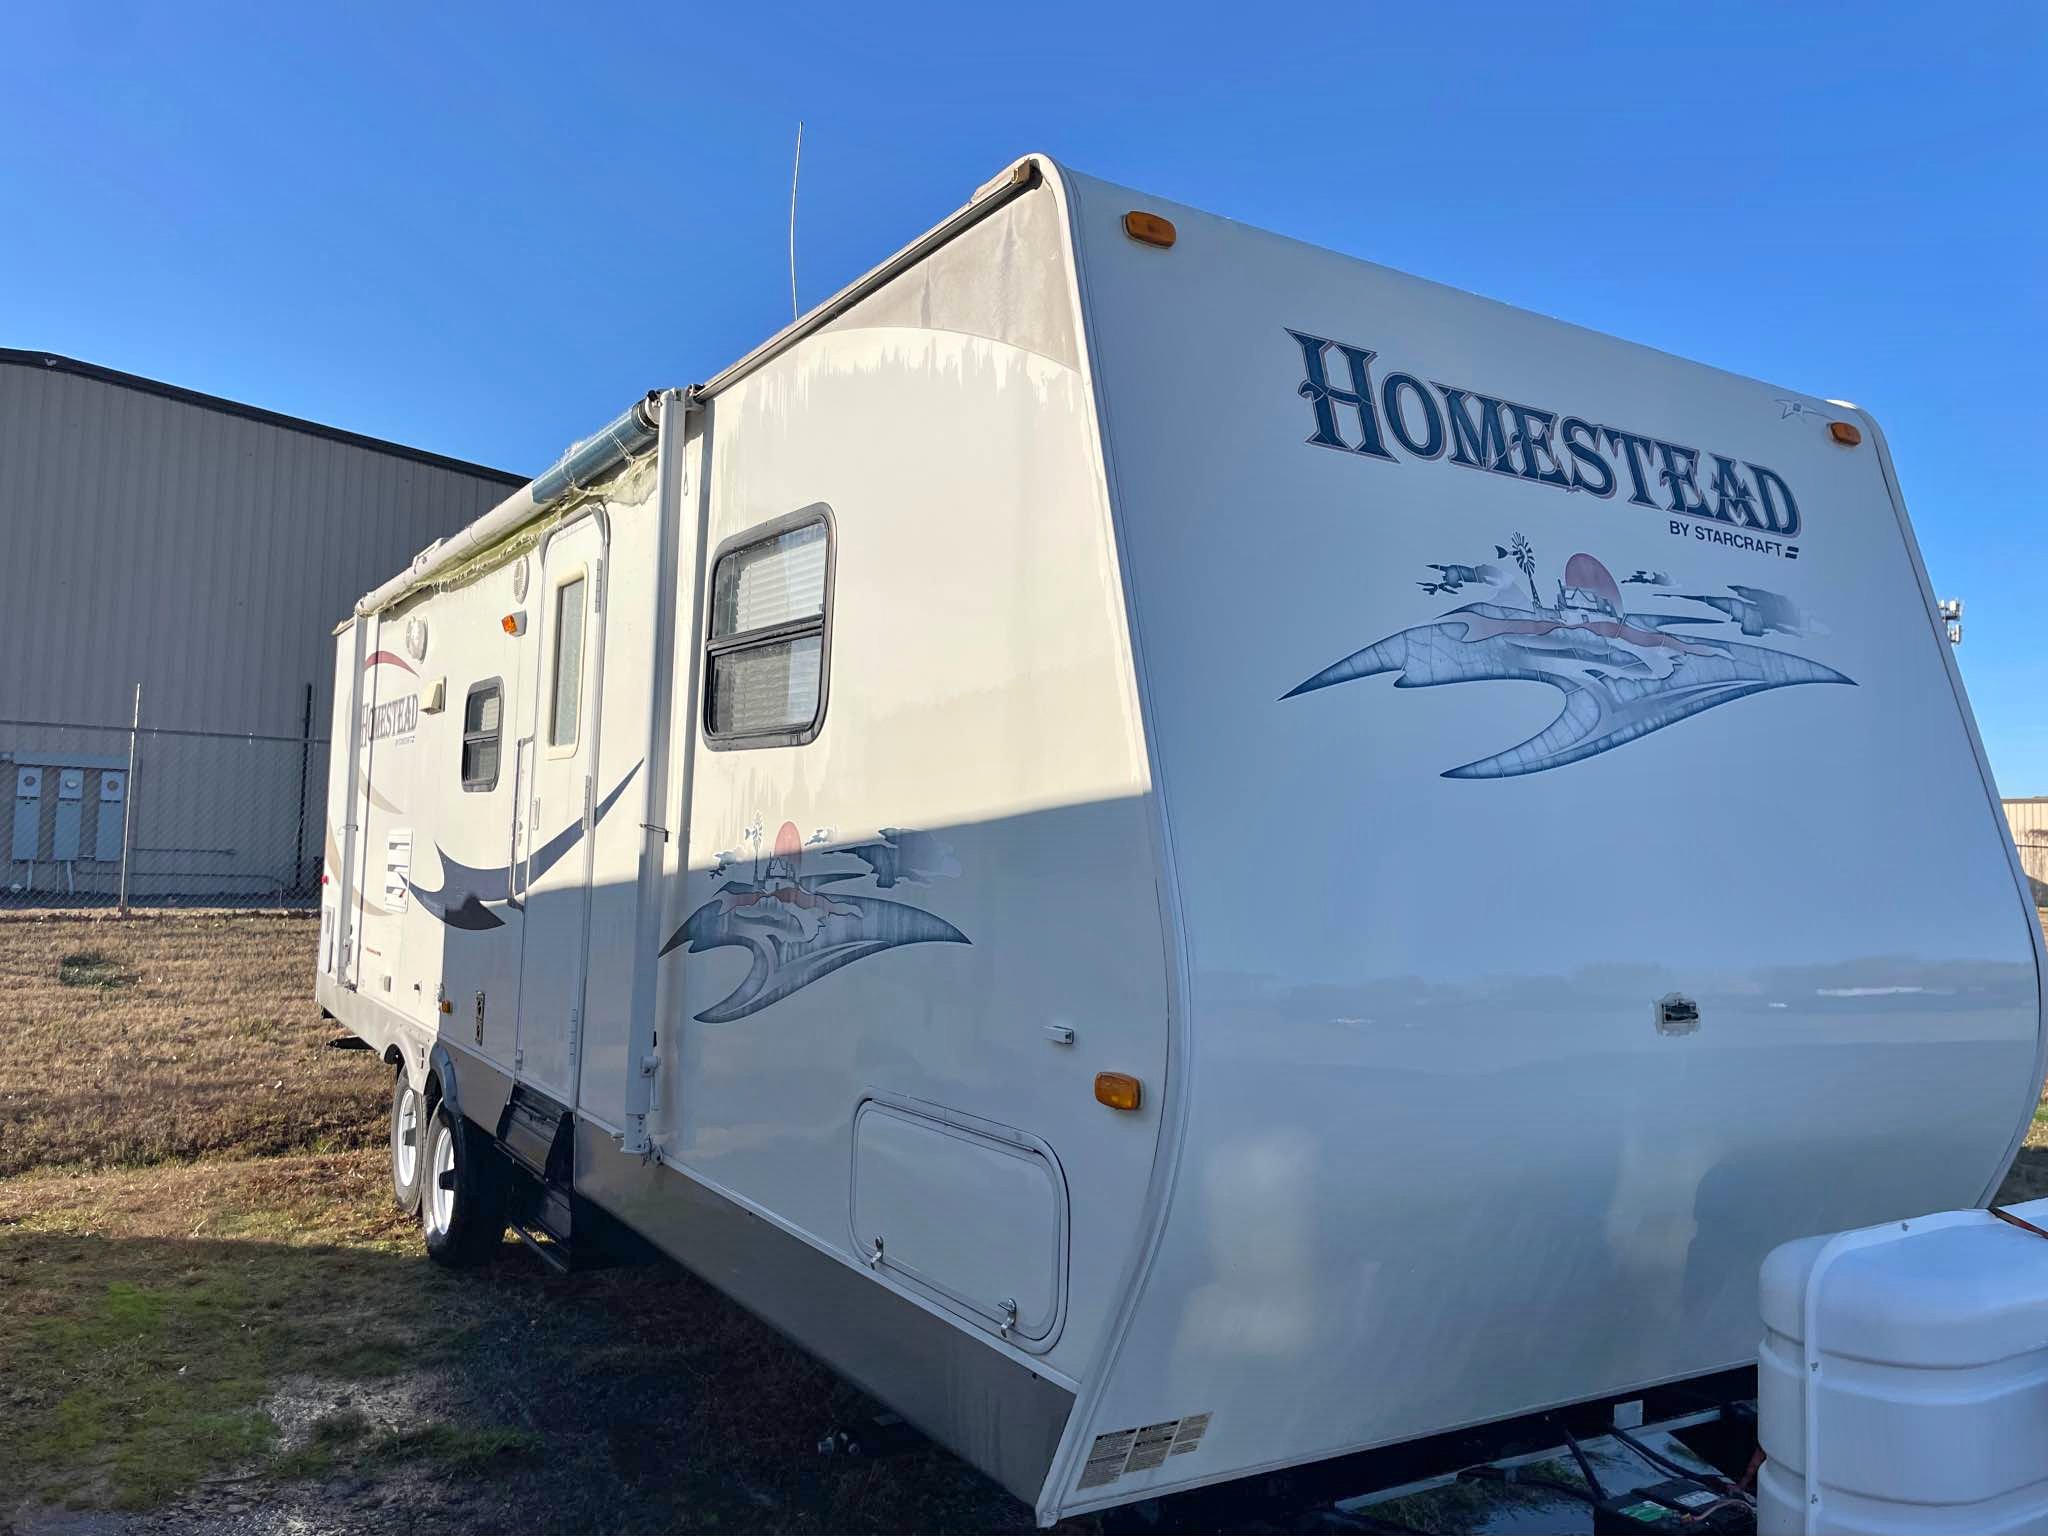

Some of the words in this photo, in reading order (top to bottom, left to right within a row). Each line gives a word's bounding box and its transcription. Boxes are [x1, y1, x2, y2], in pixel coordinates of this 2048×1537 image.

[1284, 328, 1801, 537] HOMESTEAD
[1669, 520, 1689, 537] BY
[1695, 525, 1782, 556] STARCRAFT
